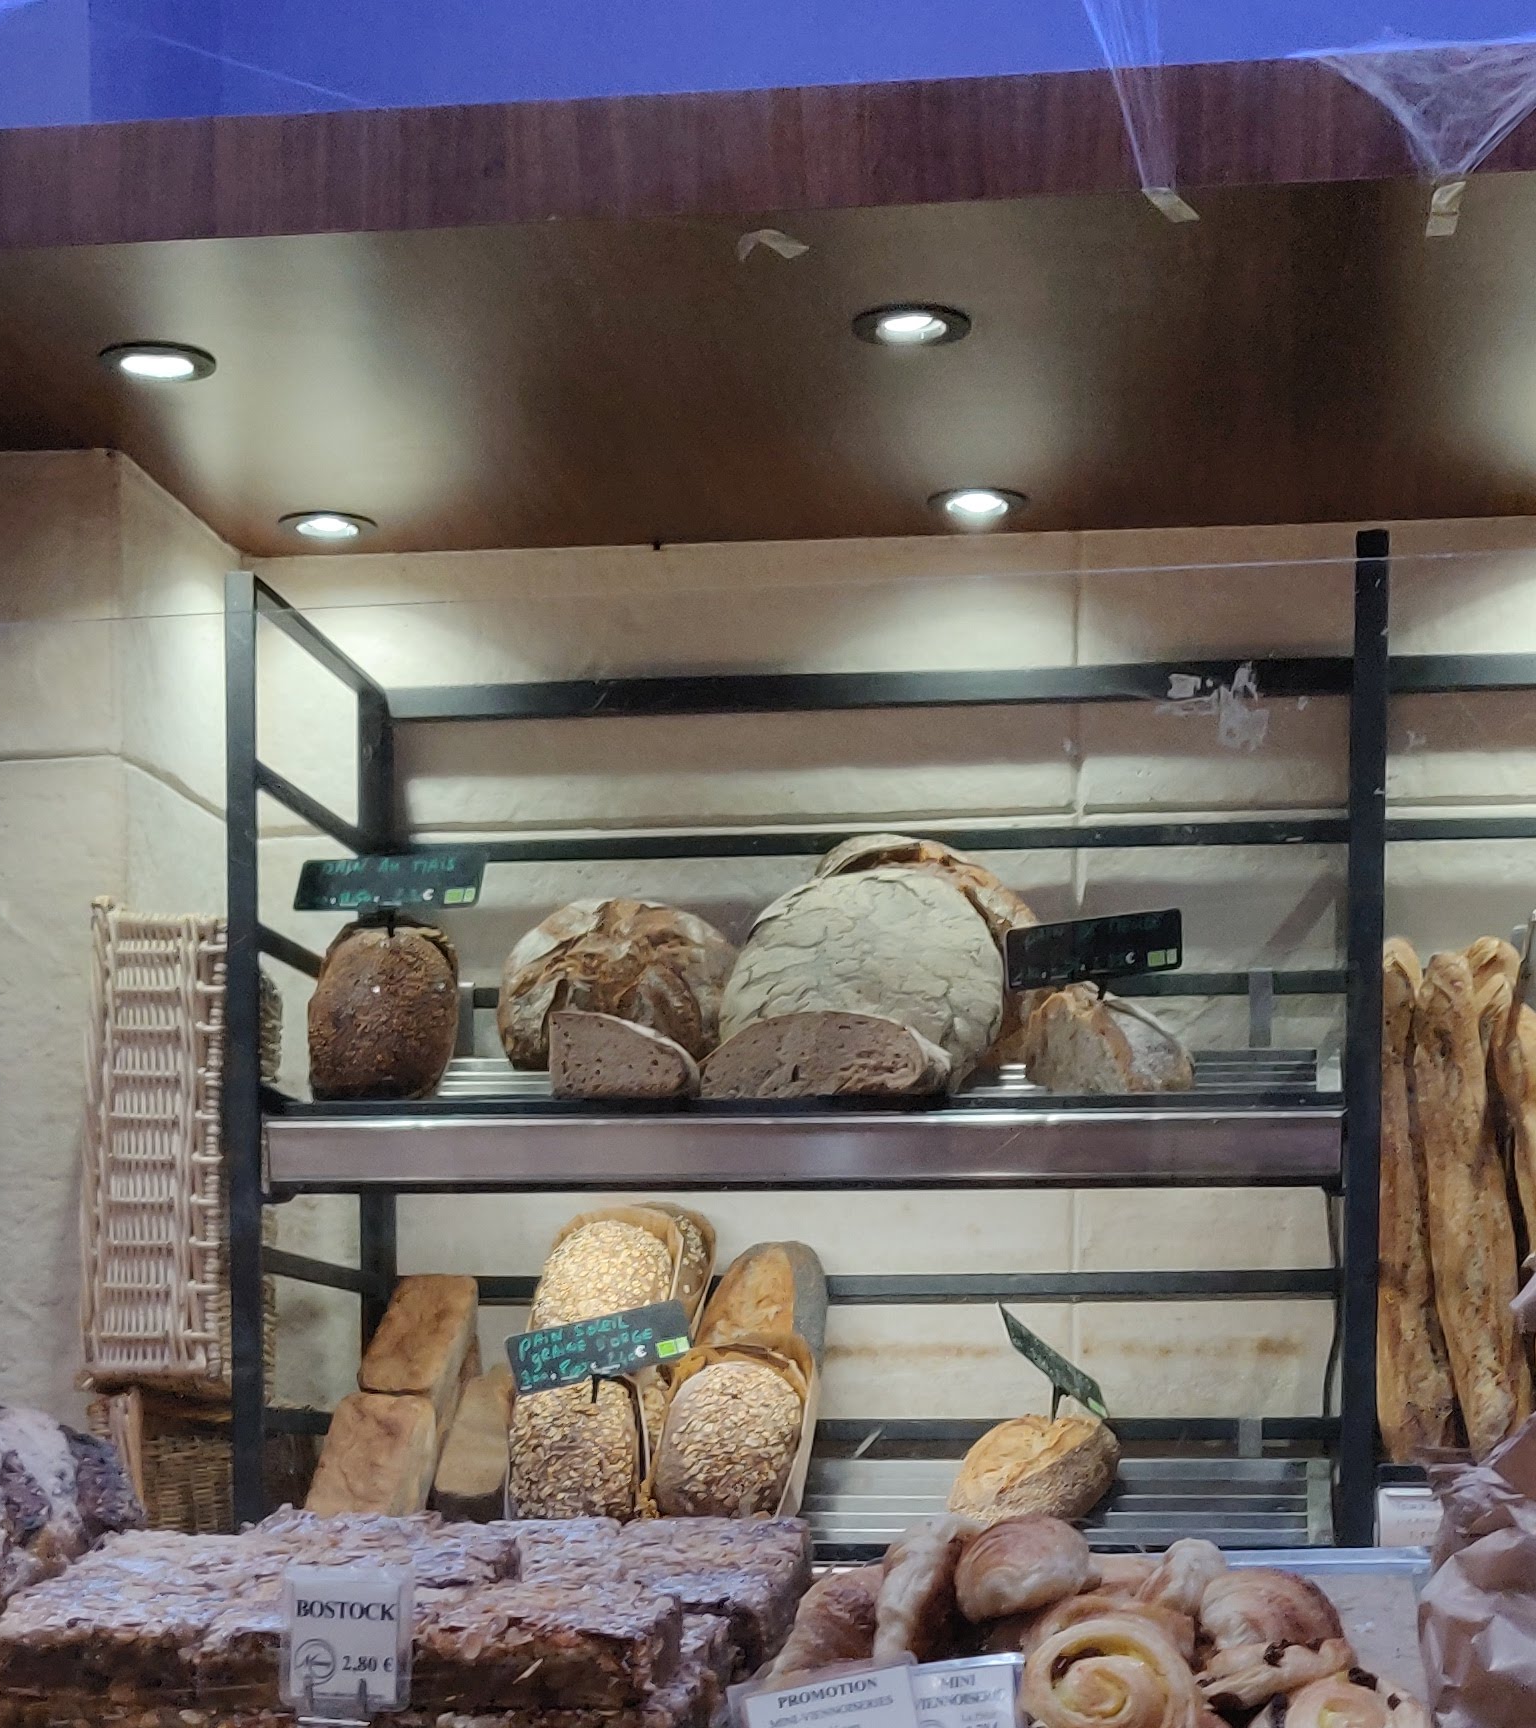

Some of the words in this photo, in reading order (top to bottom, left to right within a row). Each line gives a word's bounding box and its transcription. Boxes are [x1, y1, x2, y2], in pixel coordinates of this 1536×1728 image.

[295, 1599, 396, 1622] BOSTOCK
[341, 1655, 378, 1673] 2,80
[777, 1677, 879, 1710] PROMOTION
